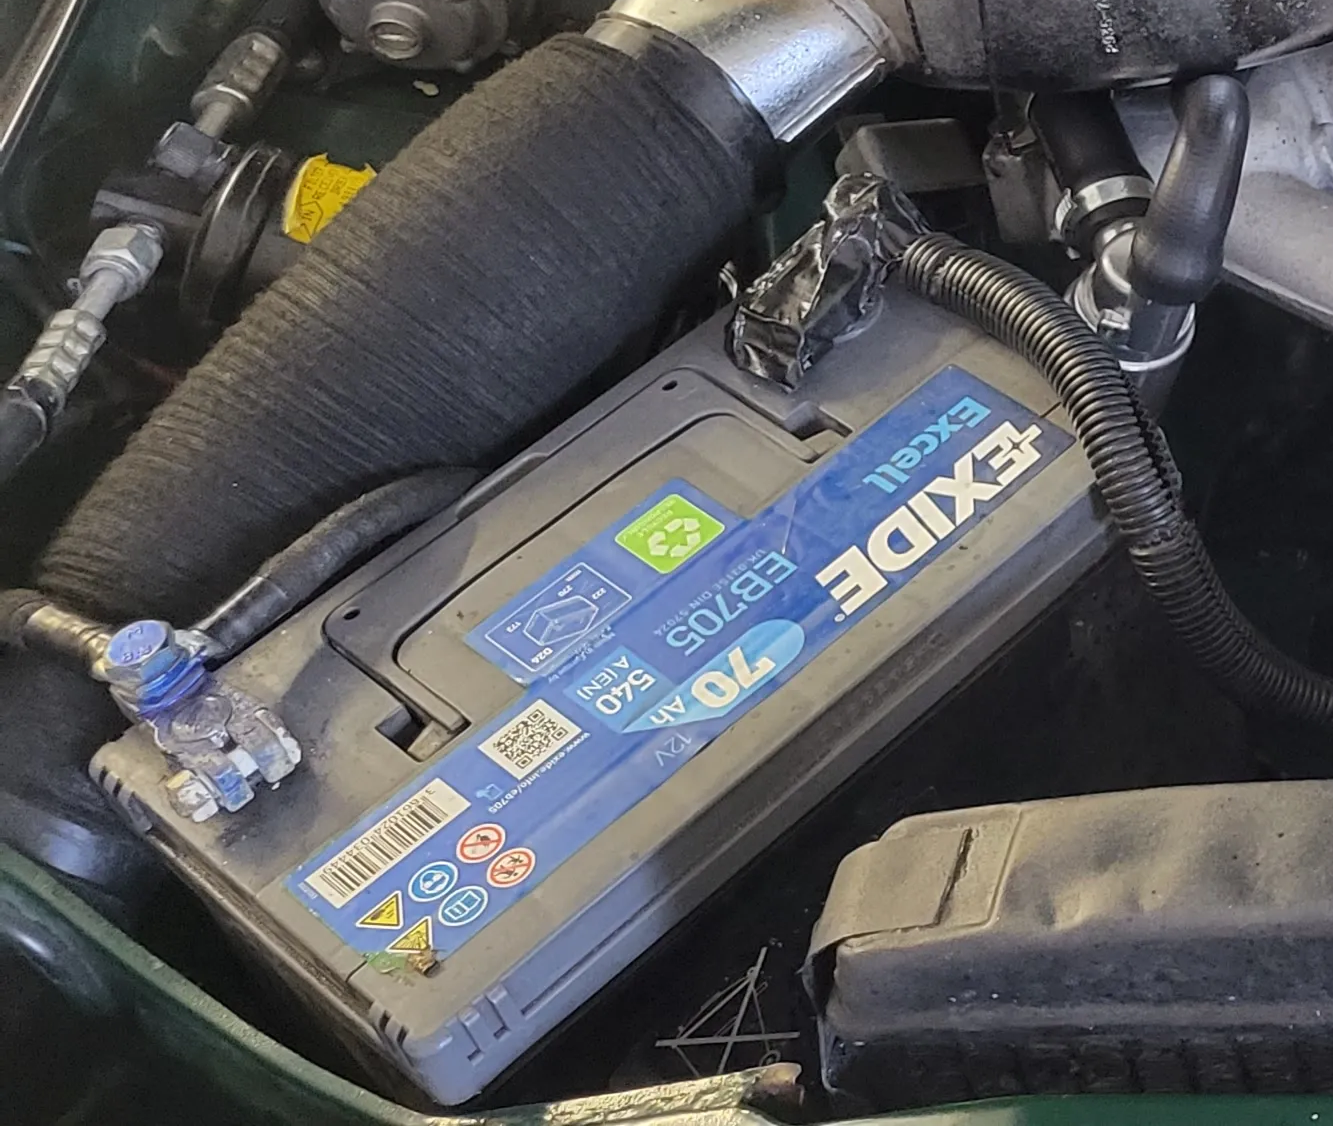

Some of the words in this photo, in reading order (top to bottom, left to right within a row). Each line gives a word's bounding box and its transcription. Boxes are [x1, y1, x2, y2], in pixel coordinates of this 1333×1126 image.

[862, 396, 992, 494] Excell
[815, 420, 1043, 617] EXIDE
[665, 550, 799, 657] EB705
[576, 667, 618, 700] (EN)
[613, 655, 630, 671] A
[691, 645, 777, 708] 70
[595, 669, 656, 715] 540
[649, 694, 687, 725] Ah
[488, 731, 592, 815] www.exide.info/eb705
[655, 732, 692, 767] 12V
